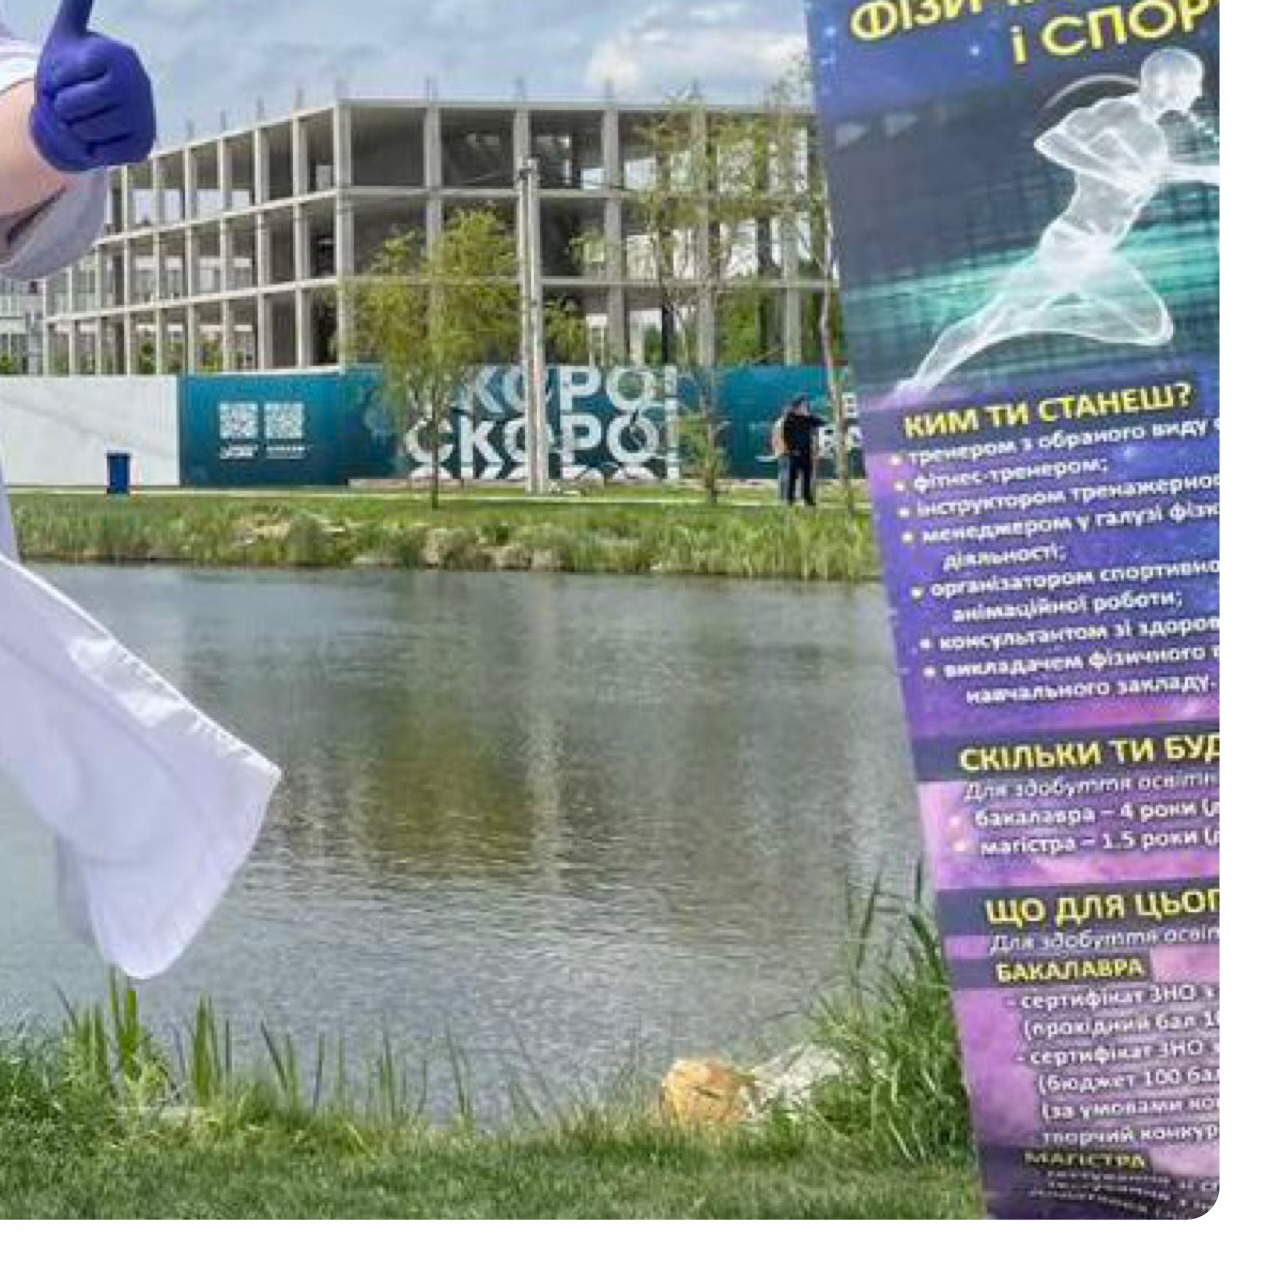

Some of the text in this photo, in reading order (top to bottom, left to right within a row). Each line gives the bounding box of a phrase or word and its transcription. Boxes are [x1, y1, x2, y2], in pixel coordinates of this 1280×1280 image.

[1010, 24, 1029, 65] і
[905, 381, 1192, 438] КИМ ТИ СТАНЕШ?
[909, 439, 1016, 465] тренером
[1039, 426, 1146, 450] обраного
[1152, 416, 1208, 438] виду
[913, 457, 1108, 493] фітнес-тренером;
[916, 490, 1067, 519] інструктором
[922, 517, 1073, 544] менеджером
[1095, 509, 1164, 530] галузі
[942, 544, 1067, 572] діяльності;
[931, 571, 1094, 599] організатором
[1093, 588, 1184, 616] роботи;
[938, 623, 1108, 652] консультантом
[942, 643, 1207, 679] викладачем фізичного
[966, 679, 1110, 706] навчального
[959, 740, 1102, 773] СКІЛЬКИ
[1109, 737, 1155, 764] ТИ
[964, 773, 1131, 803] Для здобуття
[974, 804, 1096, 828] бакалавра
[1120, 802, 1134, 819] 4
[1139, 801, 1197, 824] роки
[980, 829, 1198, 858] магістра 1.5 роки
[985, 897, 1047, 929] ЩО
[1054, 893, 1126, 928] ДЛЯ
[989, 935, 1034, 957] Для
[1041, 930, 1158, 954] здобуття
[995, 957, 1145, 983] БАКАЛАВРА
[1020, 984, 1198, 1011] сертифікат ЗНО
[1155, 1008, 1197, 1029] бал
[1030, 1040, 1204, 1067] сертифікат ЗНО
[1037, 1067, 1182, 1096] (бюджет 100
[1023, 1151, 1146, 1170] МАГІСТРА
